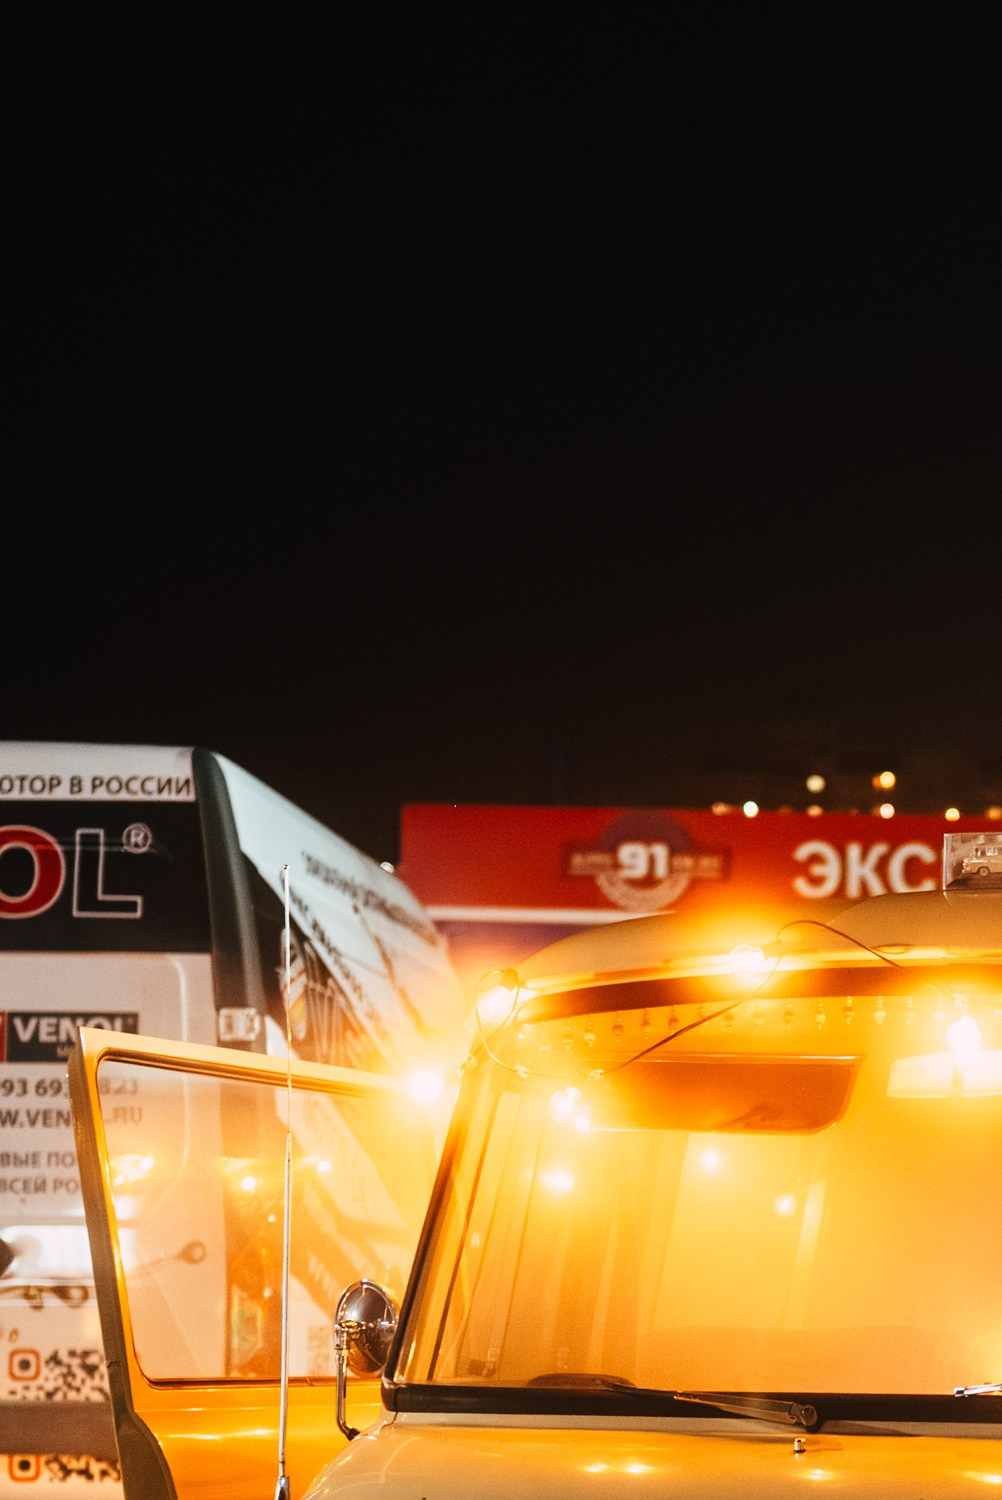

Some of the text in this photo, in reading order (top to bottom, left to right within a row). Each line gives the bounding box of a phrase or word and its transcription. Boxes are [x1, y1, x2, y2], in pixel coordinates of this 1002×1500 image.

[69, 776, 82, 795] В
[91, 775, 191, 796] РОССИИ
[616, 842, 670, 879] 91
[792, 840, 938, 899] ЭКС
